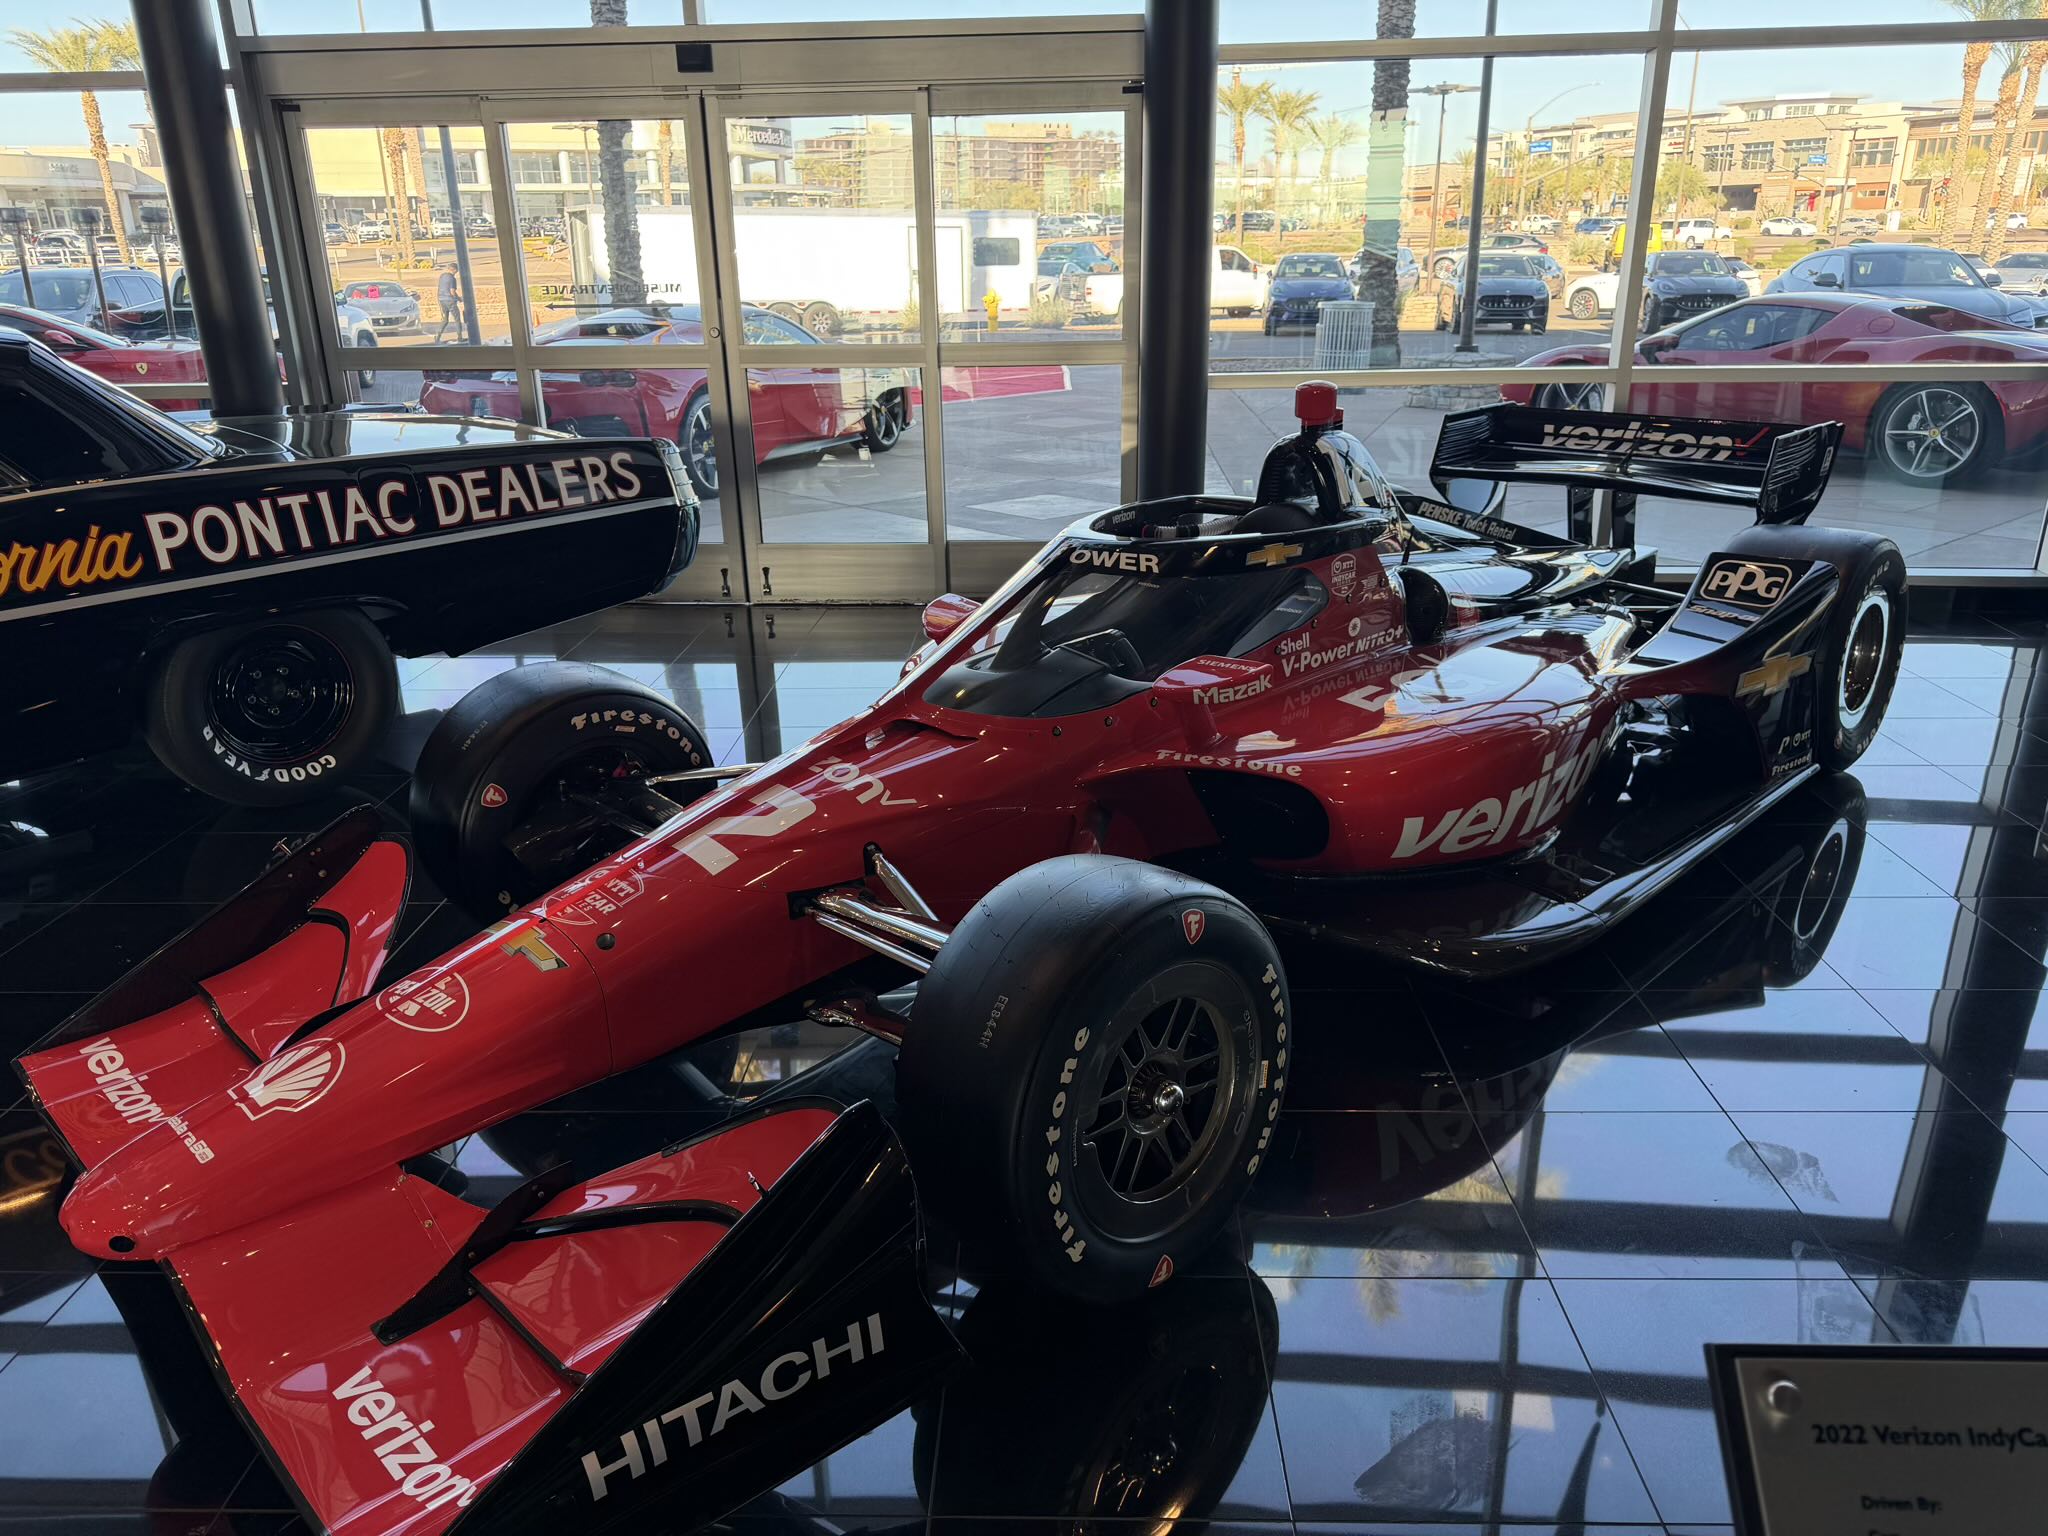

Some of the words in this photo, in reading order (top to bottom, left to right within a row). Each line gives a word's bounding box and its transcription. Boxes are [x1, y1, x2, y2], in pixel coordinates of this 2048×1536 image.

[1541, 421, 1734, 461] verizon
[143, 482, 416, 573] PONTIAC
[430, 451, 643, 529] DEALERS
[1417, 501, 1463, 526] PENSKE
[1486, 522, 1517, 541] Rental
[1707, 566, 1785, 599] PPG
[1280, 632, 1310, 656] Shell
[1281, 641, 1355, 678] V-Power
[1192, 674, 1273, 705] Mazak
[203, 723, 337, 783] GOODYEAR
[570, 709, 701, 767] Firestone
[1155, 749, 1302, 778] Firestone
[1391, 737, 1602, 859] verizo
[79, 1037, 163, 1124] verizon
[1247, 962, 1287, 1176] Firestone
[1045, 1026, 1090, 1263] Firestone
[580, 1312, 886, 1502] HITACHI
[332, 1366, 463, 1511] verizon
[1811, 1424, 1867, 1445] 2022
[1873, 1425, 1962, 1447] Verizon
[1969, 1427, 2048, 1453] IndyCa
[1861, 1496, 1913, 1511] Driven
[1916, 1496, 1943, 1515] By:
